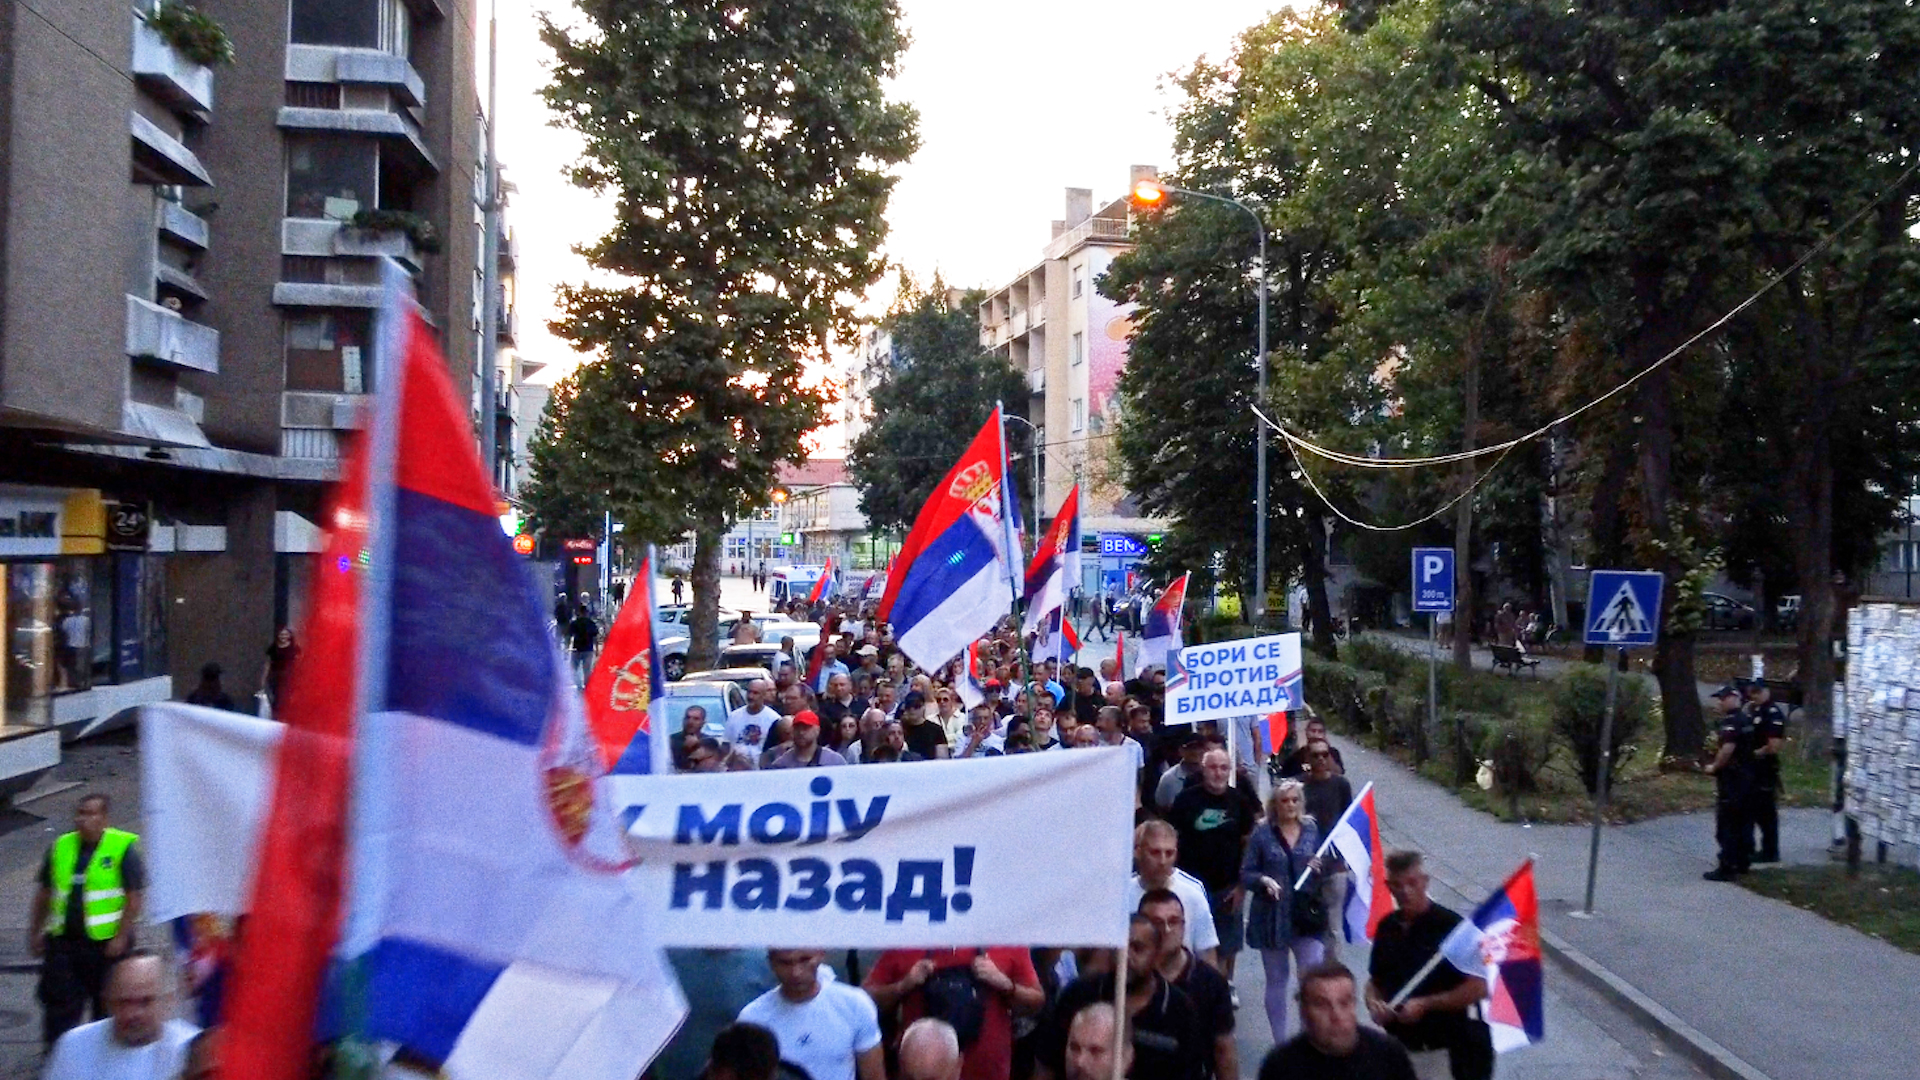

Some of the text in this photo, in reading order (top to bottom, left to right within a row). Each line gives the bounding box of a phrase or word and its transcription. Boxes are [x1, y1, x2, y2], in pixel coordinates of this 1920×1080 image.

[1104, 539, 1147, 552] BEN
[1423, 555, 1444, 583] P
[1186, 642, 1281, 669] БОРИ СЕ
[1188, 664, 1279, 691] ПРОТИВ
[1177, 686, 1290, 714] БЛОКАДА
[669, 845, 976, 923] назад!
